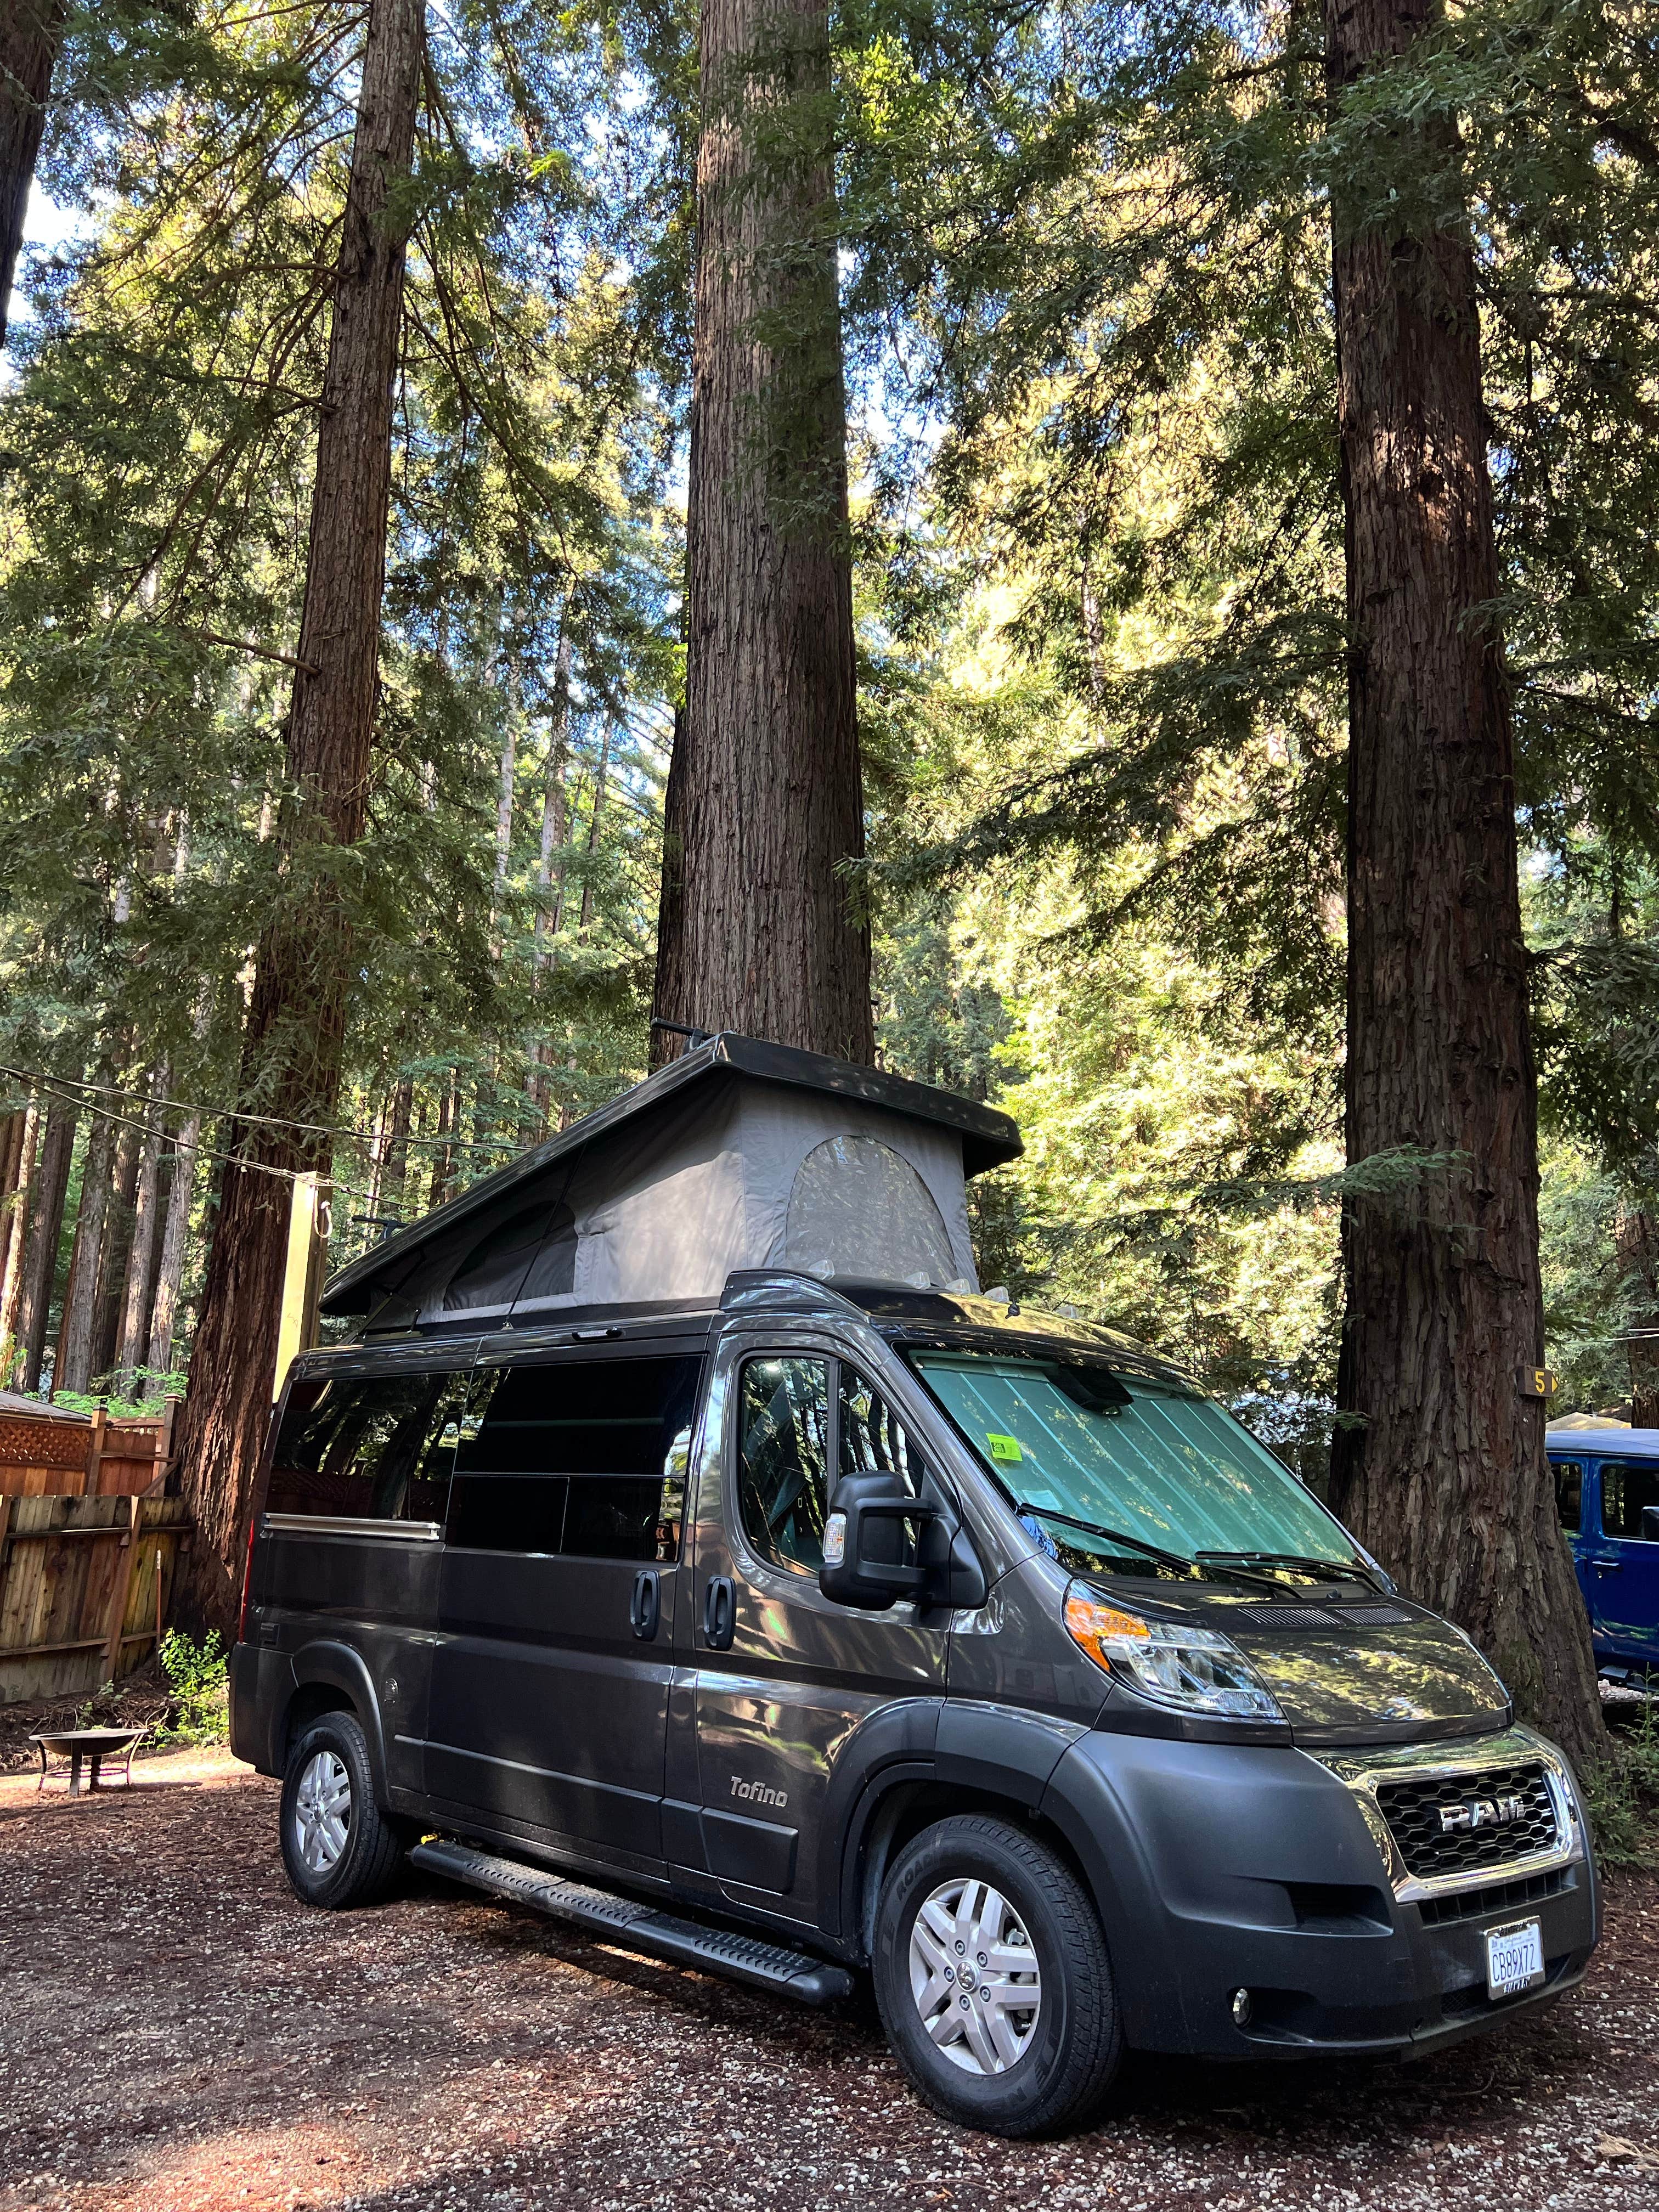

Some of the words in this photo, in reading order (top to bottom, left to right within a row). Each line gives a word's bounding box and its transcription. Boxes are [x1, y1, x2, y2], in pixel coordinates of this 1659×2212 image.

[1534, 1371, 1545, 1393] 5
[730, 1775, 789, 1808] Tofino
[1438, 1795, 1526, 1831] RAM
[1492, 1943, 1536, 1982] CB89X72
